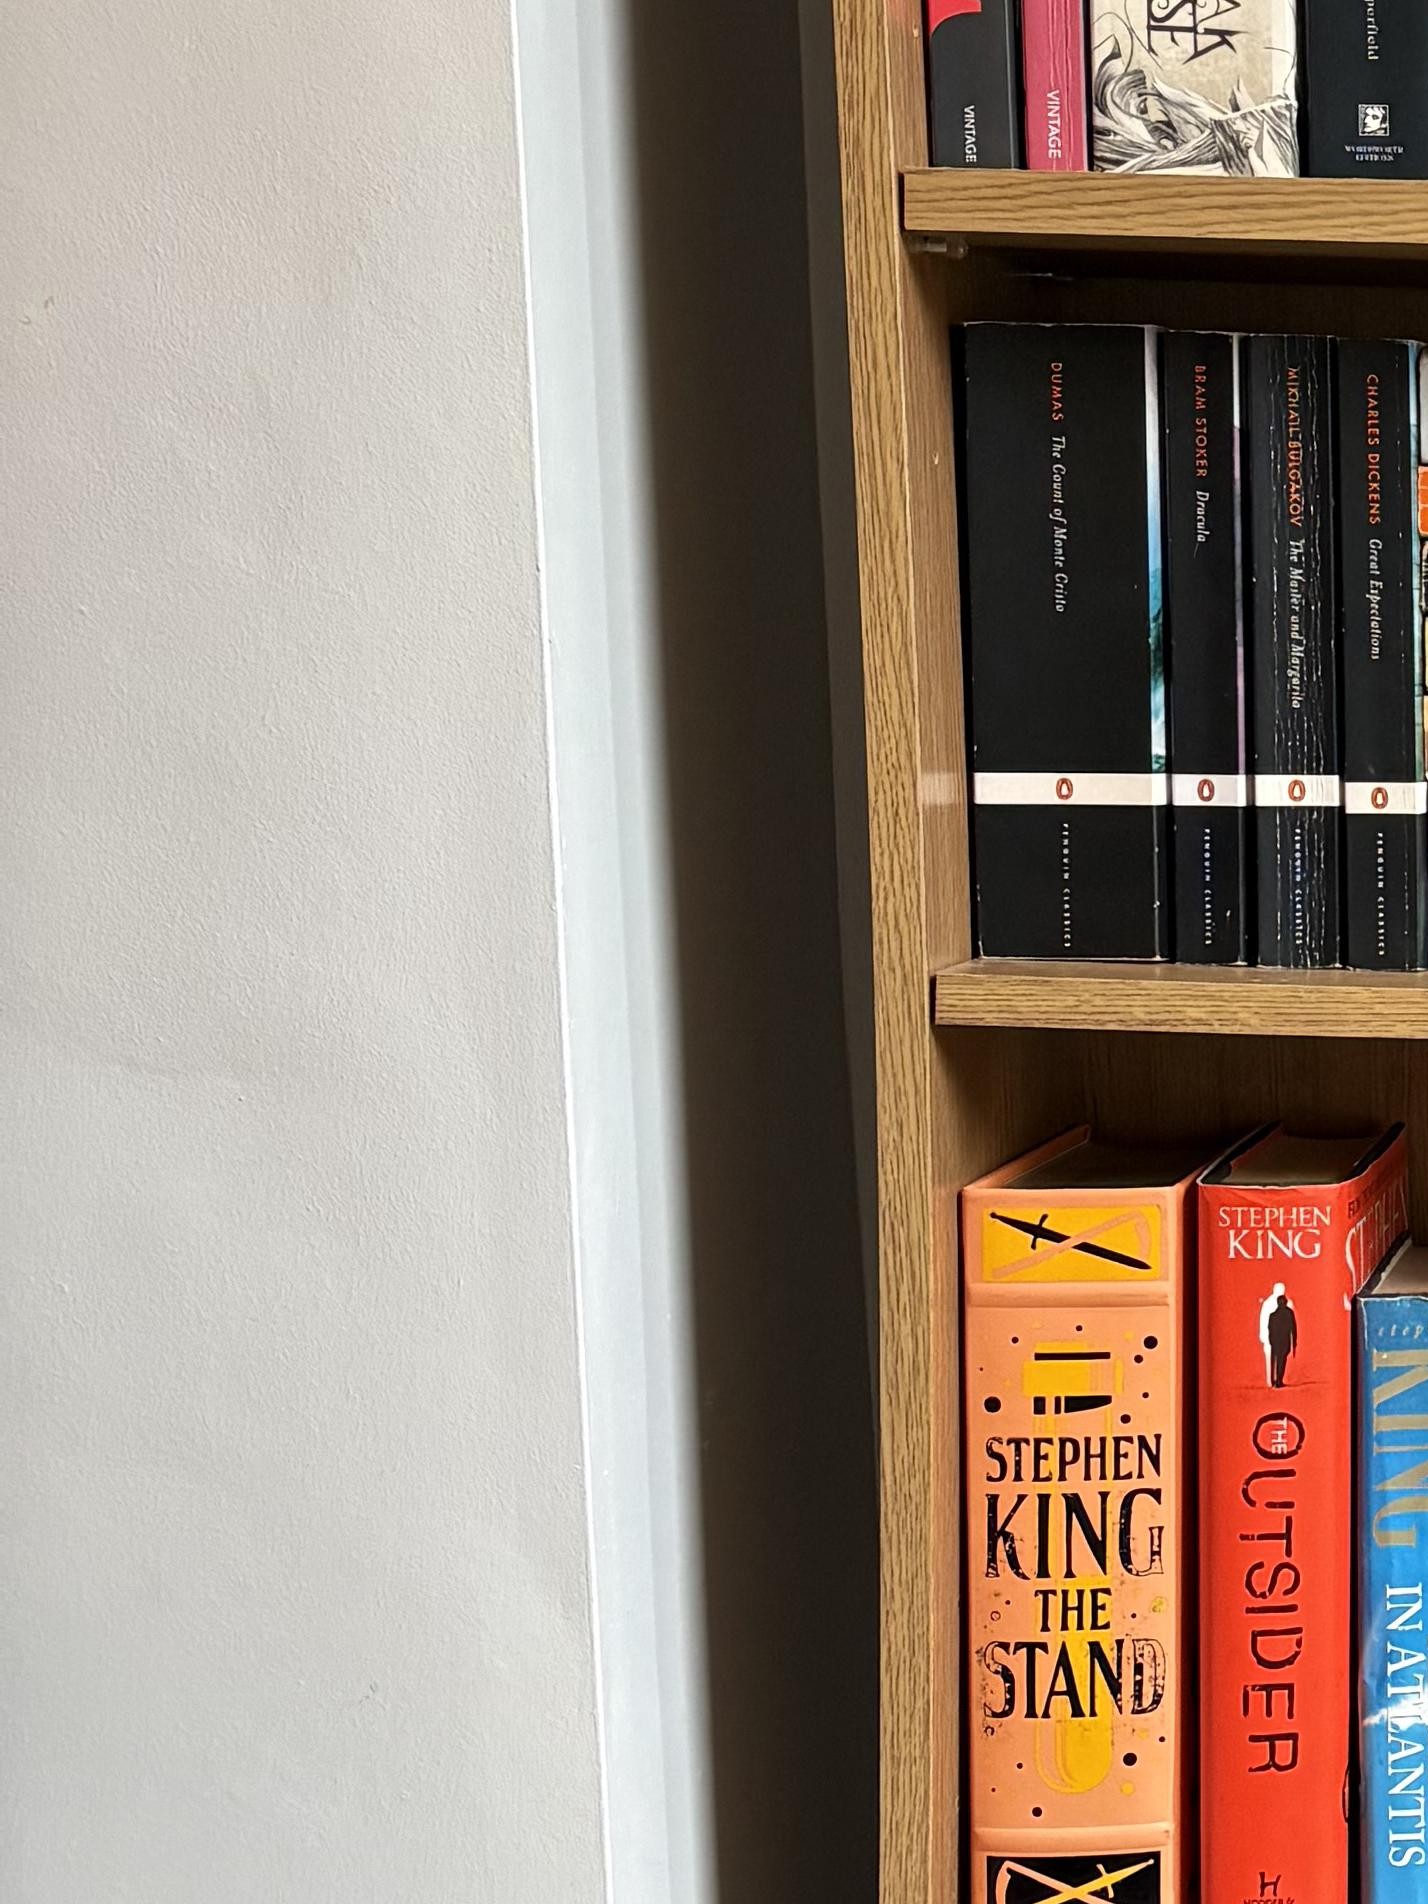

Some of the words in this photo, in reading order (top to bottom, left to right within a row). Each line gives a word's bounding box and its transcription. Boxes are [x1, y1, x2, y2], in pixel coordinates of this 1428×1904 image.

[1046, 89, 1060, 159] VINTAGE
[985, 1433, 1162, 1483] STEPHEN
[985, 1489, 1165, 1581] KING
[1034, 1589, 1111, 1632] THE
[1238, 1411, 1306, 1776] OUTSIDER
[983, 1638, 1167, 1720] STAND
